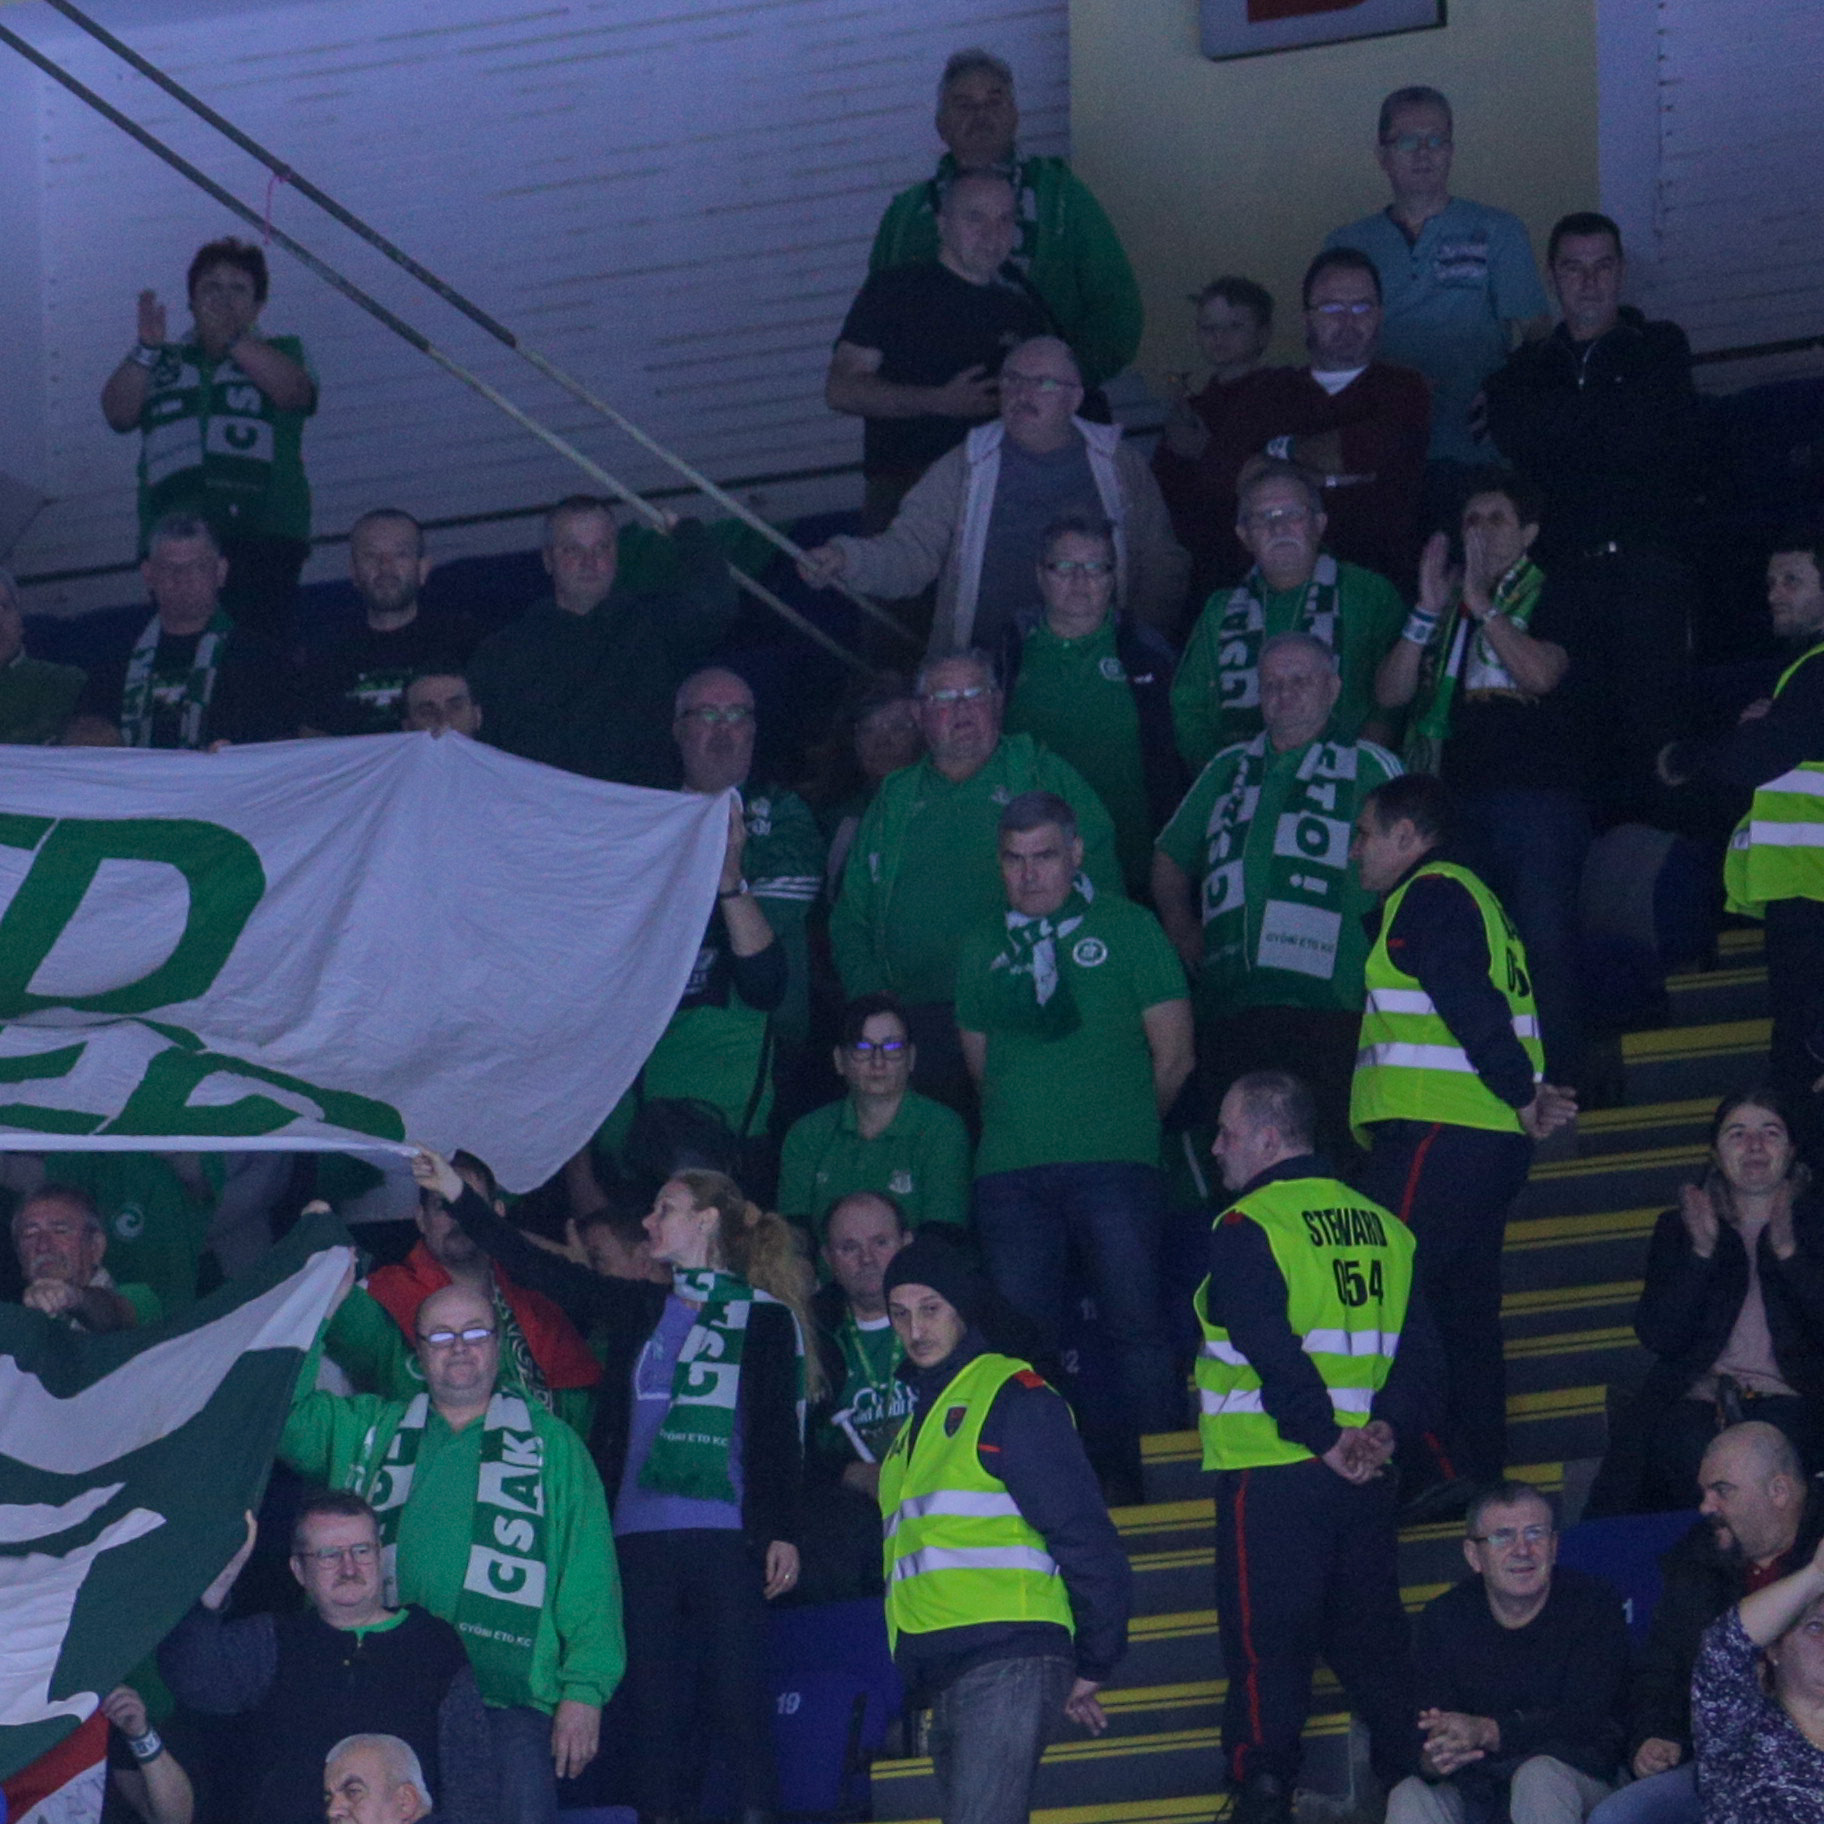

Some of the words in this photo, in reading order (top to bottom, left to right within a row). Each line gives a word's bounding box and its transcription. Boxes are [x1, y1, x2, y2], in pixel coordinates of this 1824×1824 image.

[1300, 1207, 1389, 1248] STEWARD
[1333, 1258, 1385, 1308] 054
[777, 1691, 801, 1715] 19
